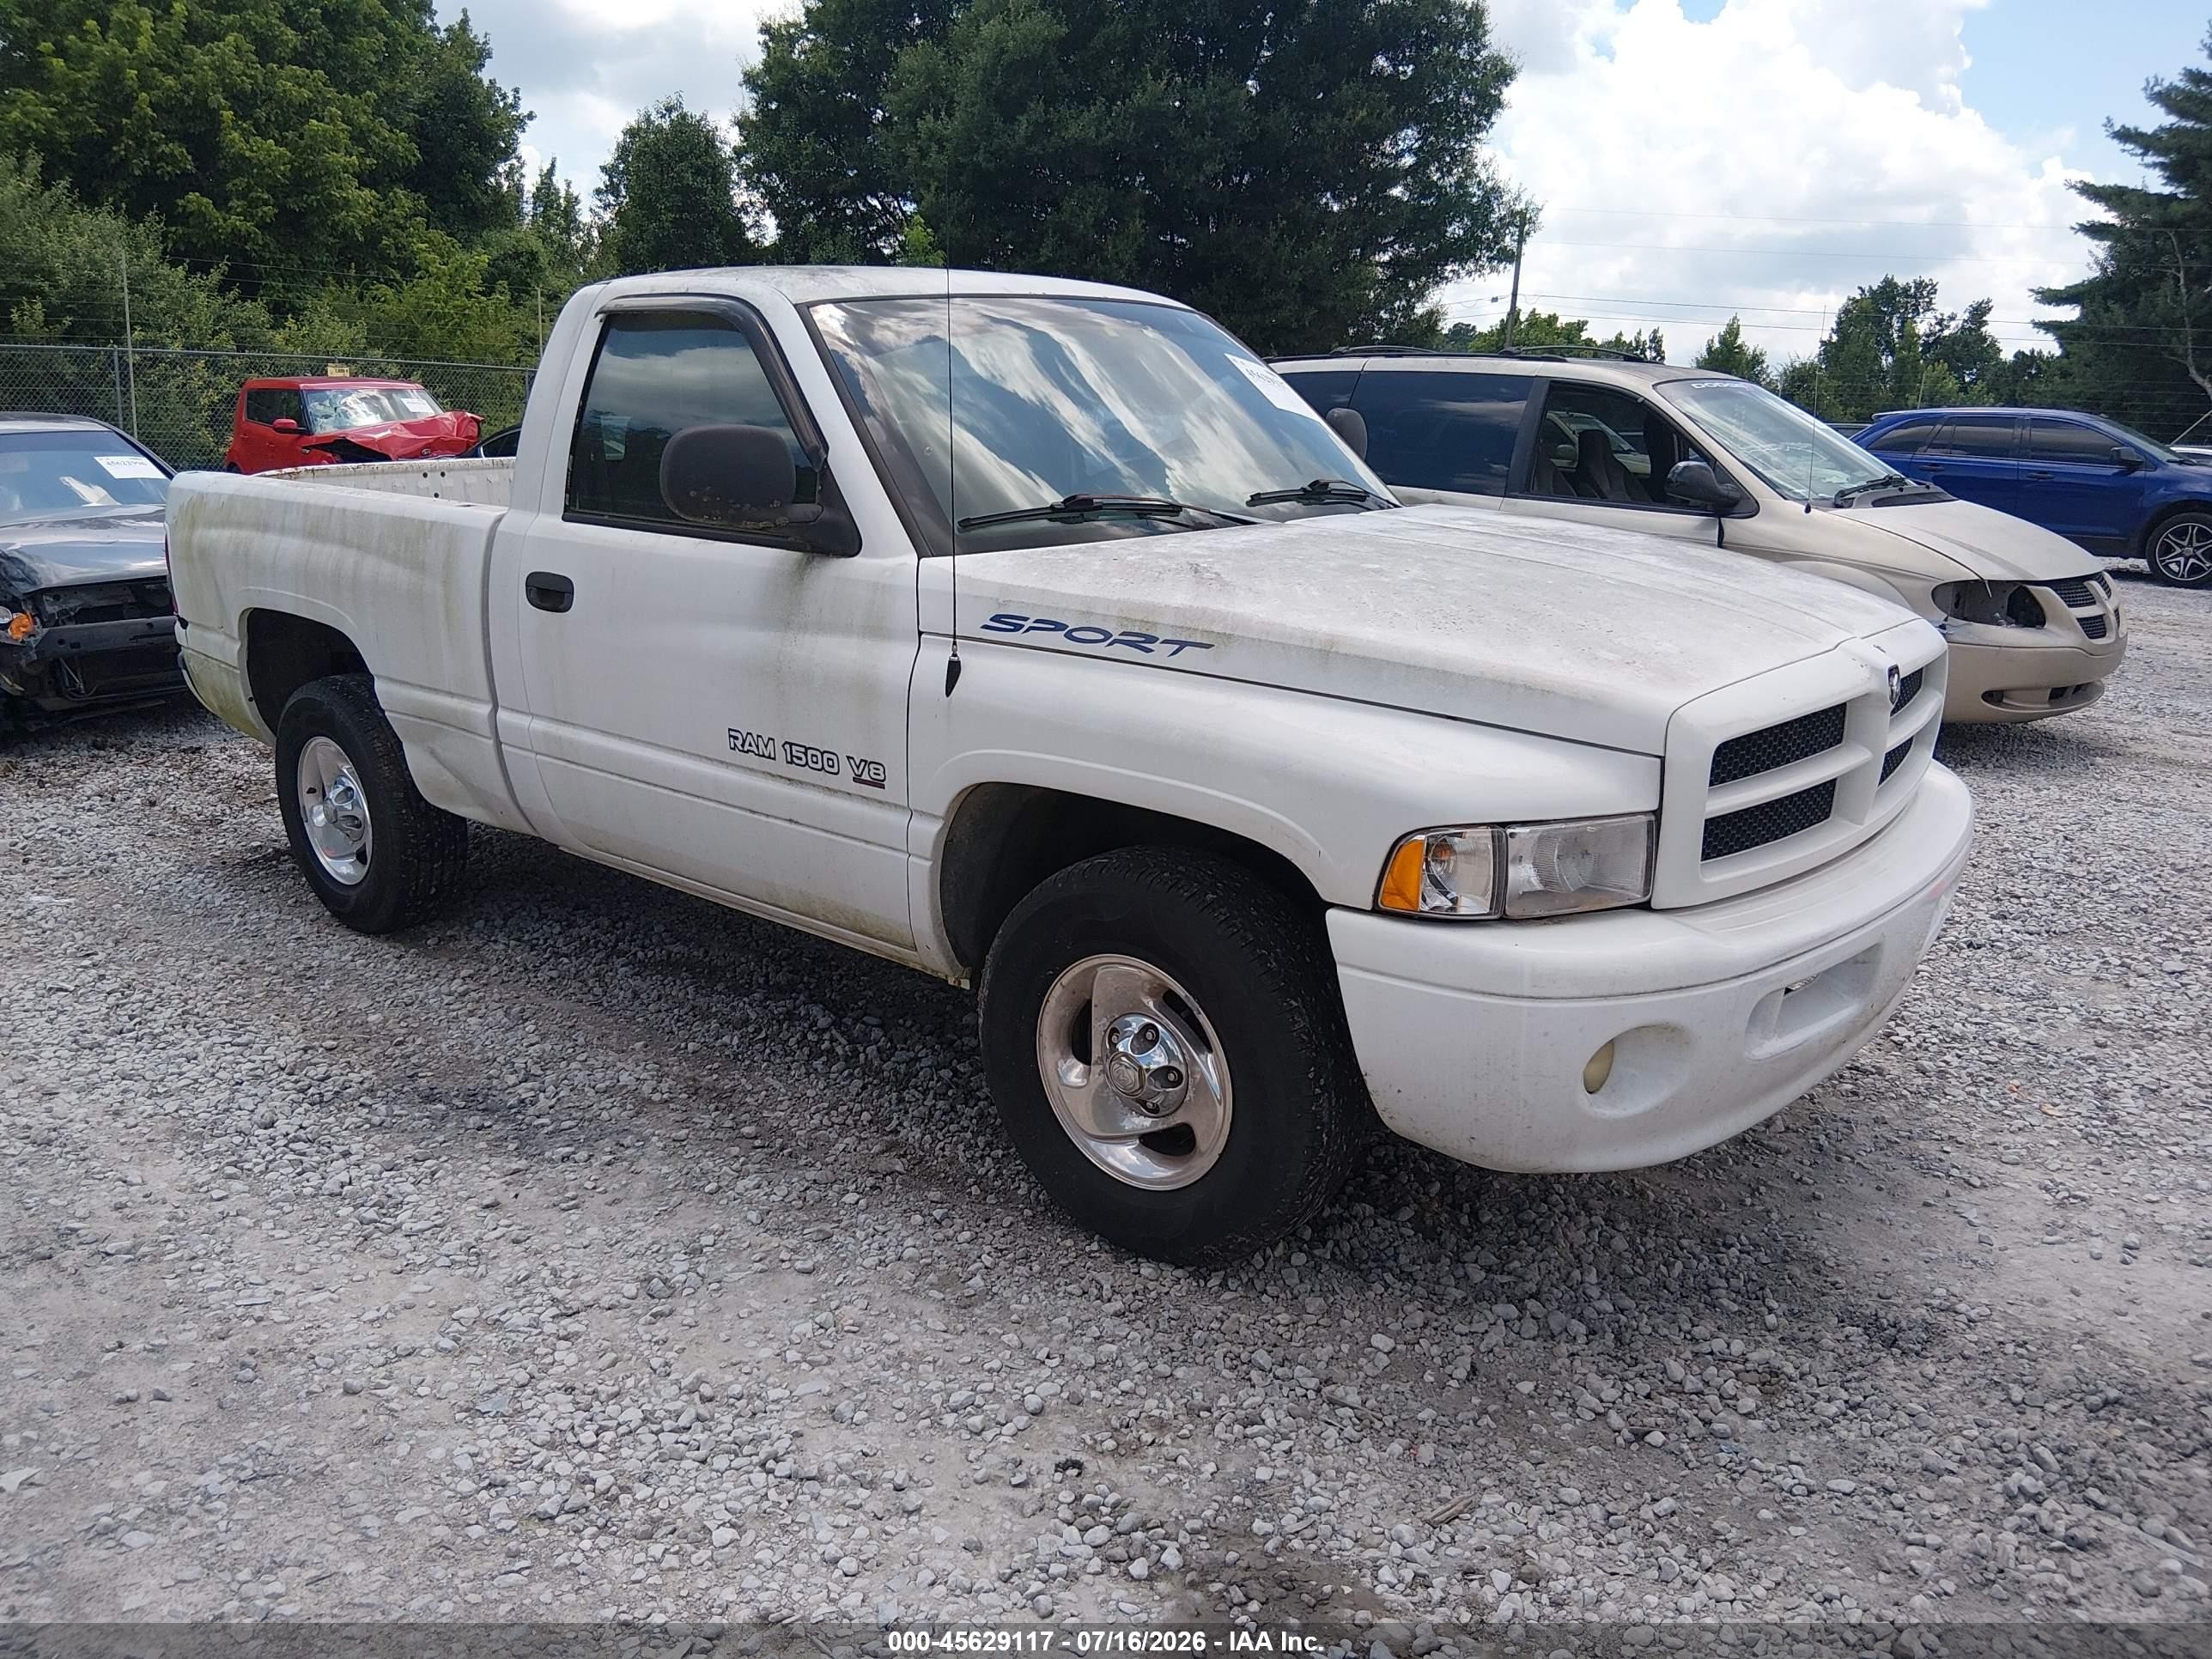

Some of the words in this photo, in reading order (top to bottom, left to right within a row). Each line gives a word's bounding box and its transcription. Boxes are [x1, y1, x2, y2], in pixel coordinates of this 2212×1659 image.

[980, 613, 1215, 658] SPORT
[728, 727, 776, 761] RAM
[782, 741, 840, 775] 1500
[846, 755, 886, 783] V8
